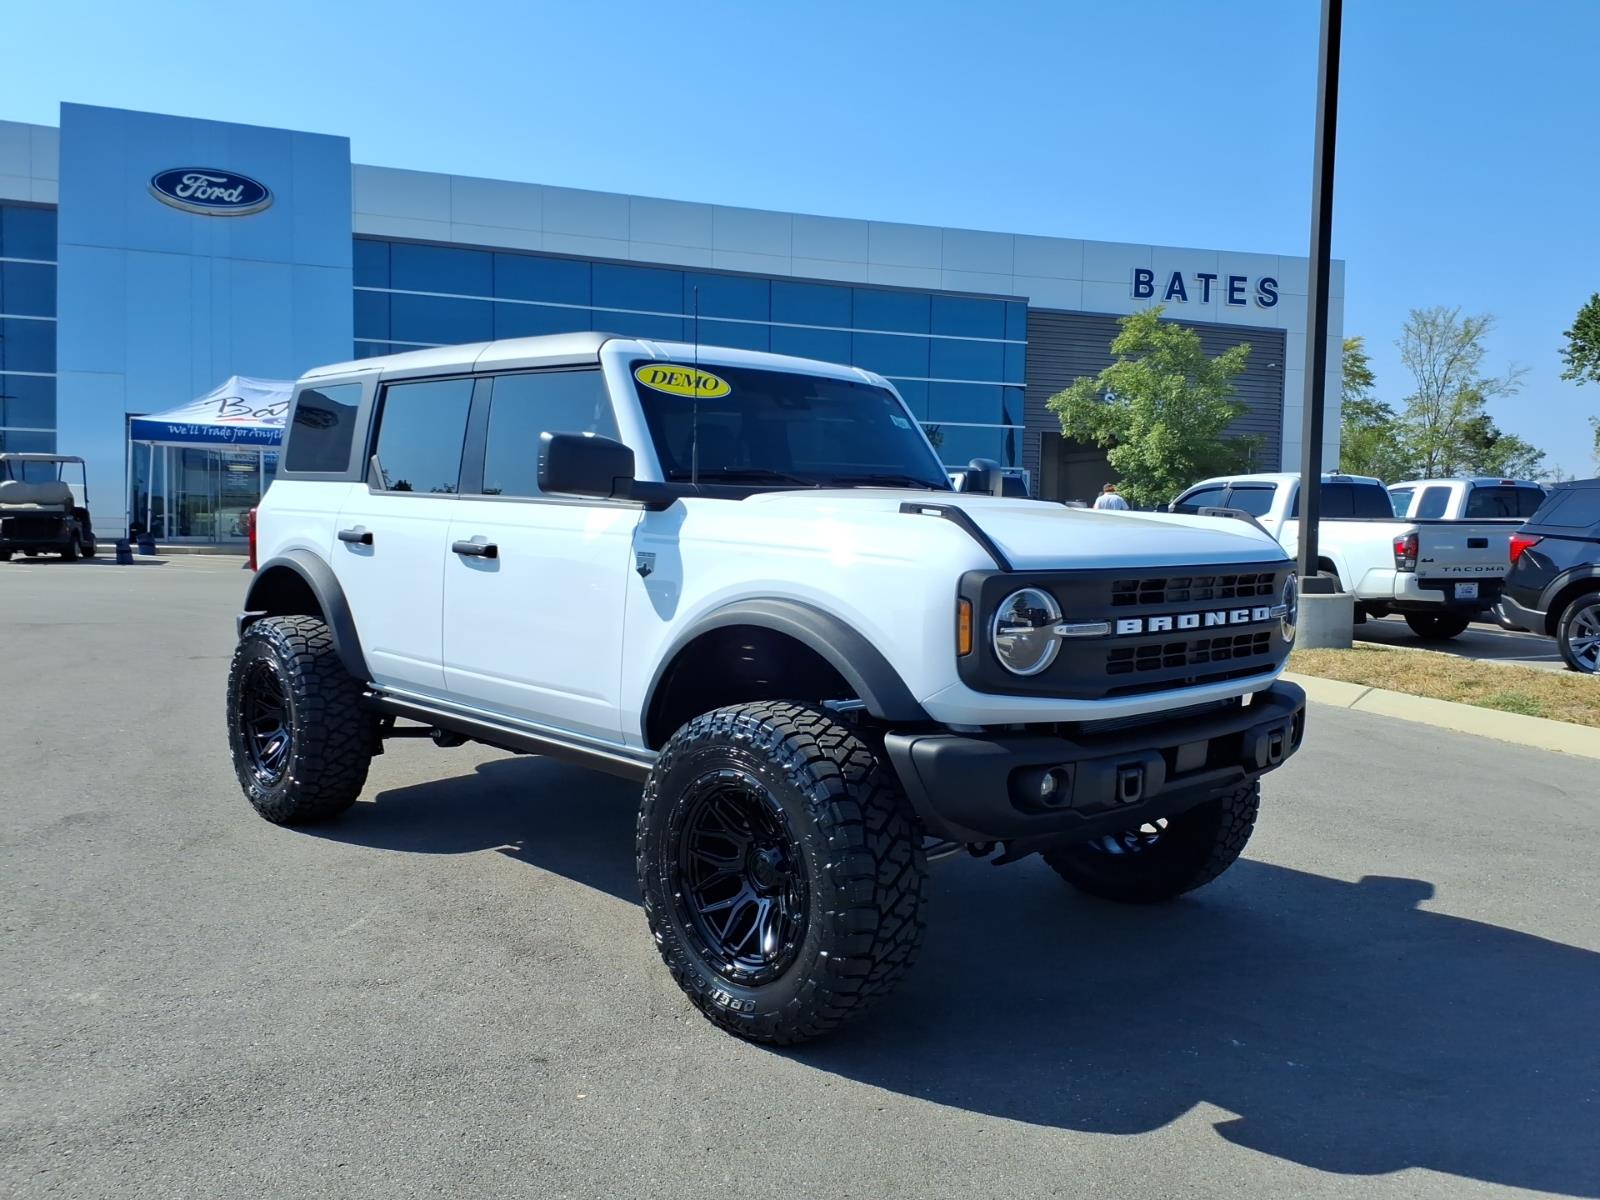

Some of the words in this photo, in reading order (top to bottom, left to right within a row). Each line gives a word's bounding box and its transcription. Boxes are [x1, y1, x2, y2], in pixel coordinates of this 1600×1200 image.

[176, 173, 244, 203] Ford
[1132, 268, 1279, 308] BATES
[650, 369, 719, 390] DEMO
[167, 424, 199, 435] We'll
[201, 425, 232, 439] Trade
[231, 427, 249, 442] for
[1116, 606, 1270, 635] BRONCO
